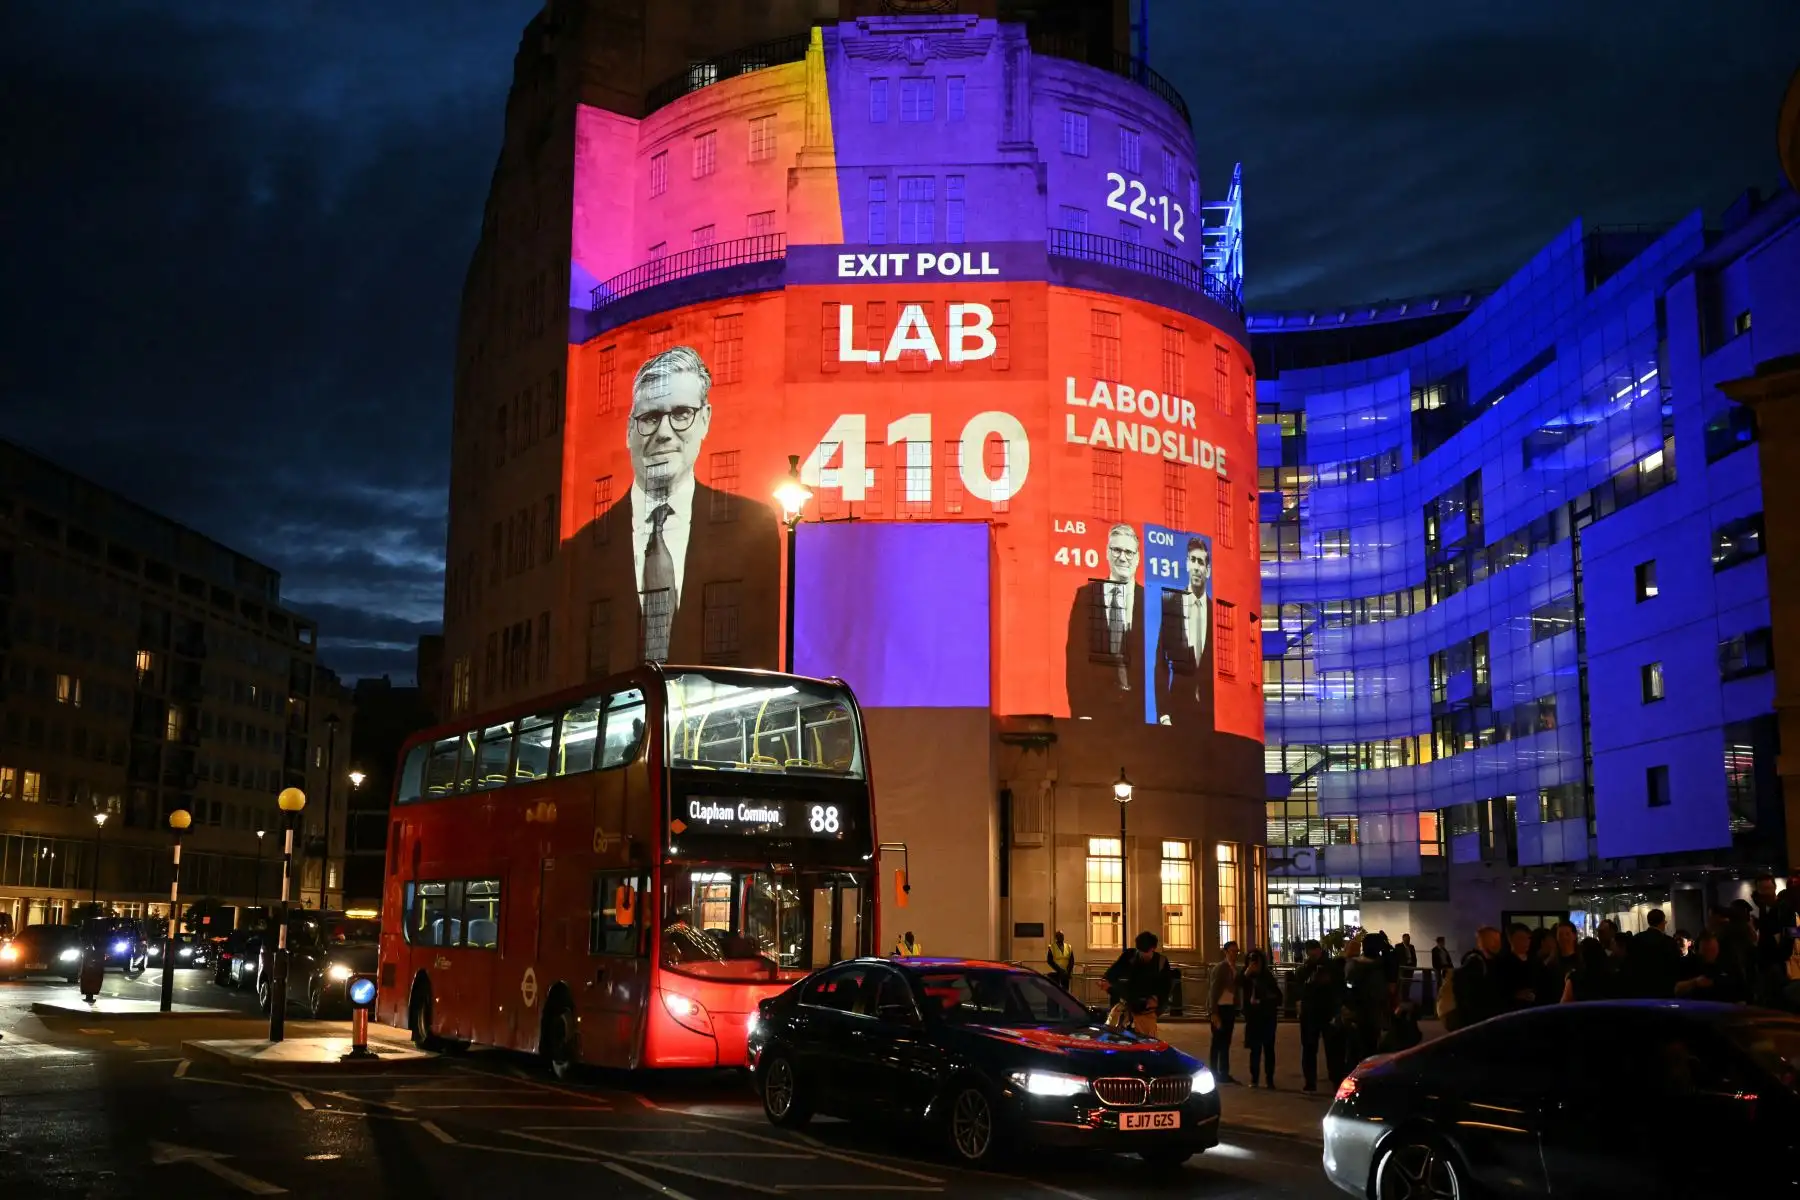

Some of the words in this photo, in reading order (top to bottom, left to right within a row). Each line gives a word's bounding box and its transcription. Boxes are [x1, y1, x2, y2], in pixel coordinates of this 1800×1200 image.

[1107, 172, 1184, 242] 22:12
[837, 252, 909, 278] EXIT
[917, 251, 1000, 276] POLL
[838, 302, 998, 364] LAB
[1066, 376, 1197, 430] LABOUR
[801, 412, 1030, 501] 410
[1066, 413, 1227, 476] LANDSLIDE
[1054, 519, 1087, 534] LAB
[1149, 531, 1173, 546] CON
[1055, 547, 1098, 567] 410
[1149, 558, 1179, 578] 131
[689, 800, 734, 824] Clapham
[737, 802, 779, 823] Common
[809, 804, 839, 833] 88
[1127, 1114, 1150, 1128] EJ17
[1154, 1113, 1174, 1127] GZS
